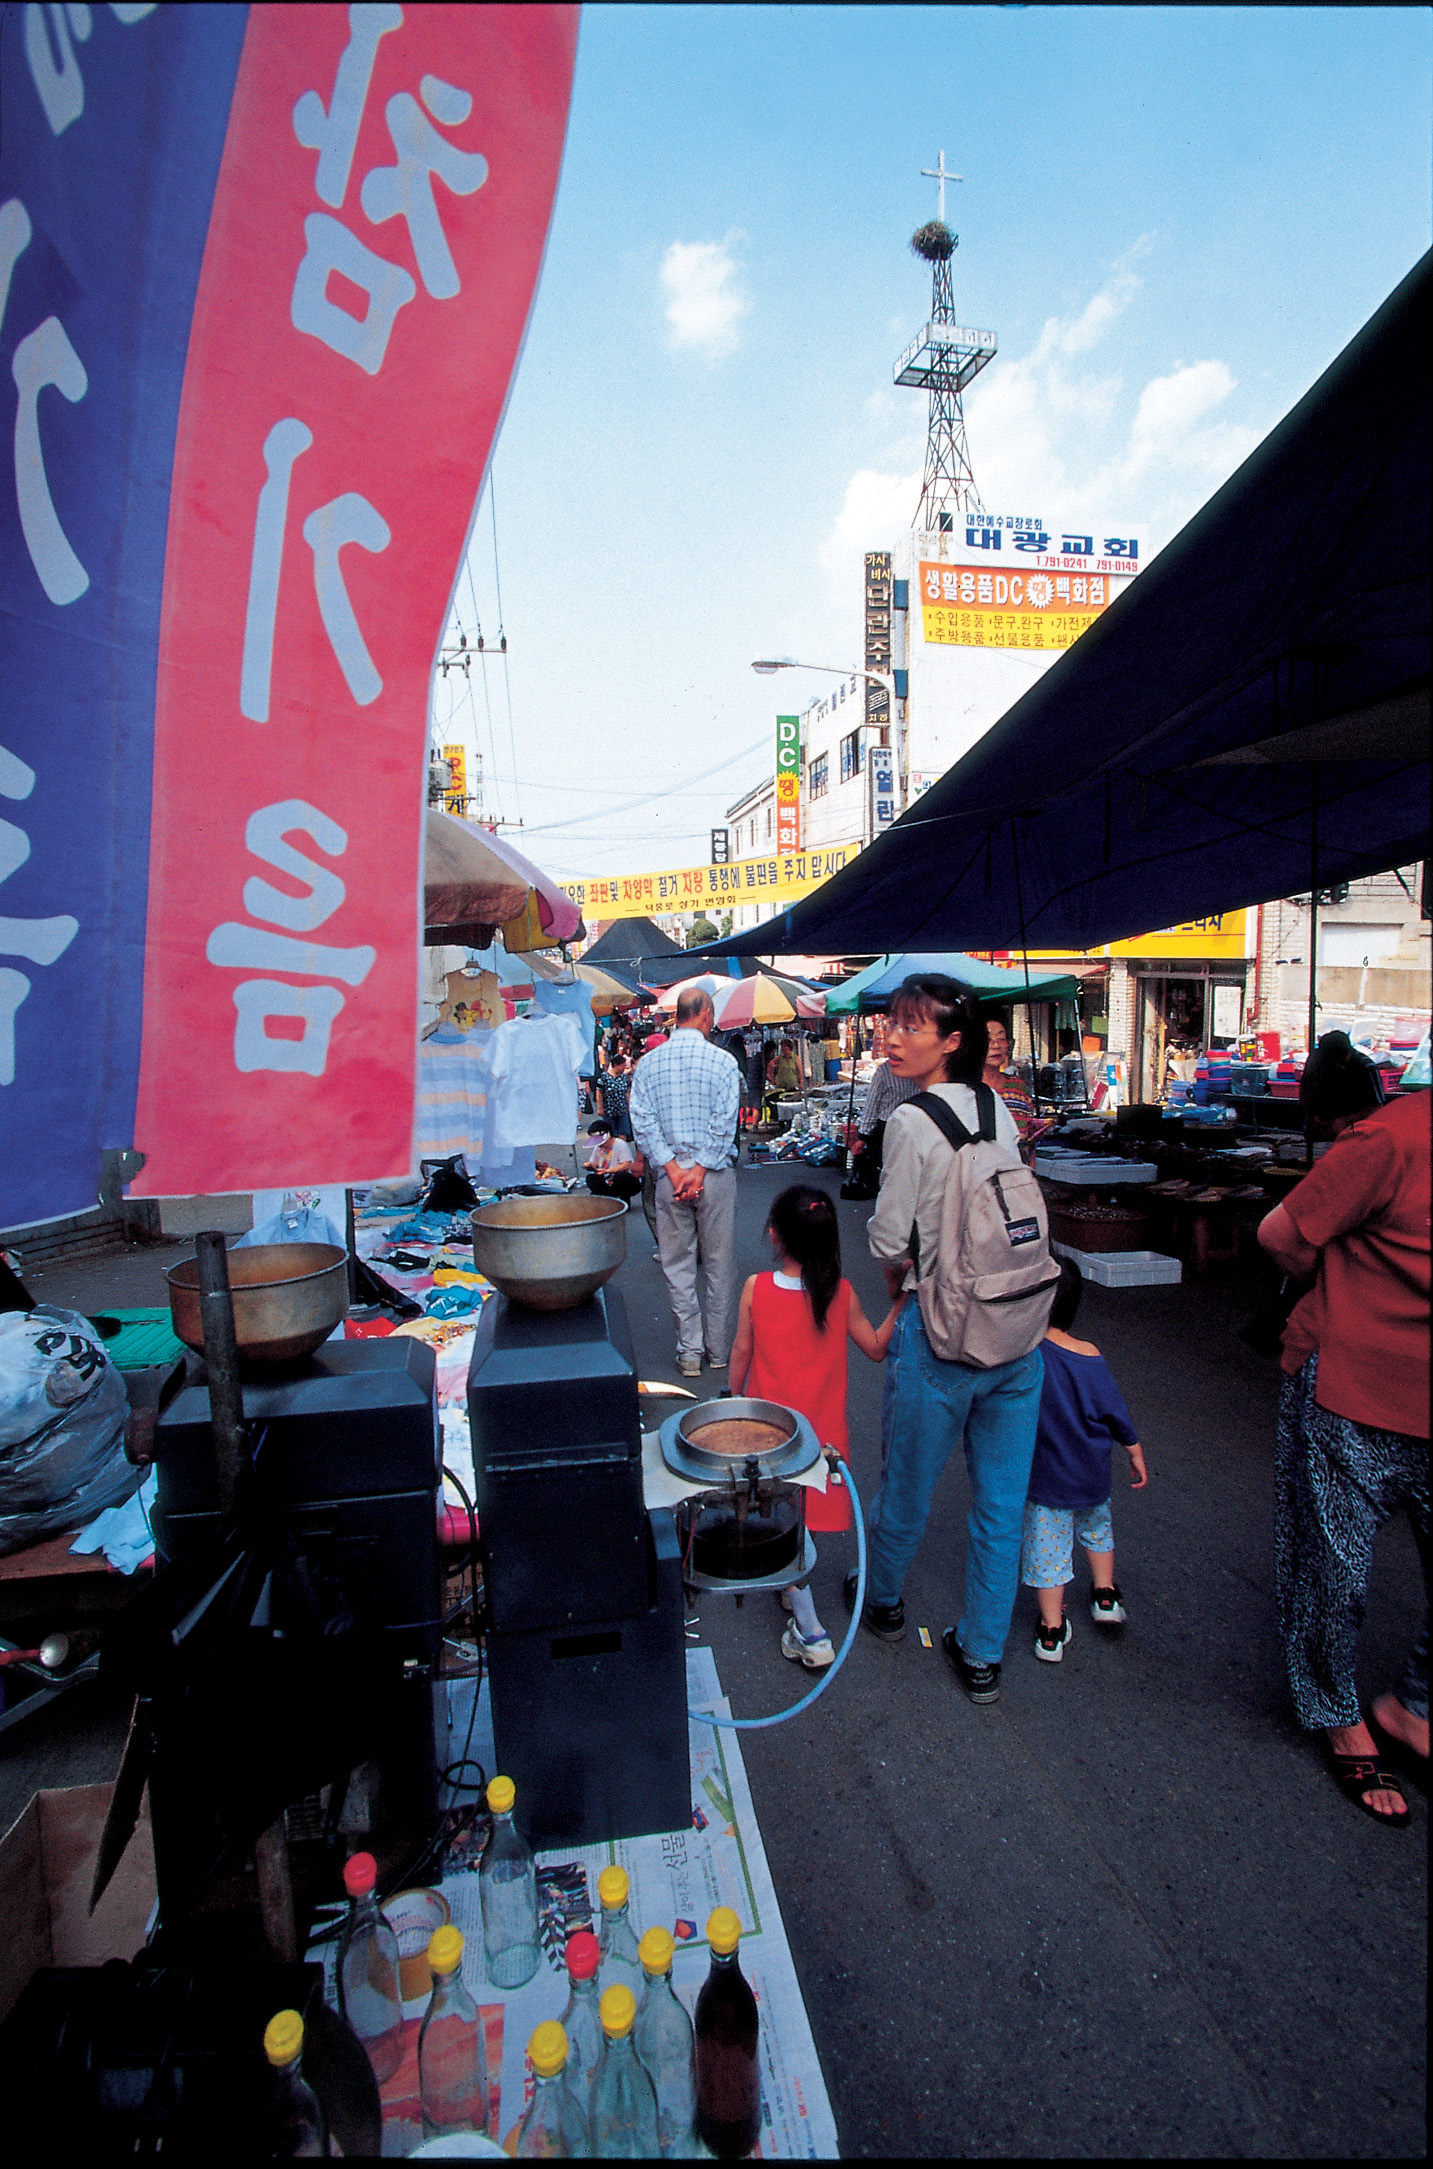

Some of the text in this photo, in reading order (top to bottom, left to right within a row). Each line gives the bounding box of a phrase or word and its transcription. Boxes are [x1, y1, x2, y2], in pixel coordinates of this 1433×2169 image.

[966, 514, 1042, 530] 대한예수교장로회
[966, 528, 1138, 559] 대광교회
[1096, 560, 1138, 572] 791-0149
[1056, 575, 1105, 605] 백화점
[935, 611, 985, 628] 수입용품
[1056, 616, 1098, 630] 가전제
[935, 627, 985, 645] 주방용품
[994, 632, 1045, 647] 선물용품
[709, 866, 740, 892] 통행에
[746, 861, 778, 887] 불편을
[661, 1834, 688, 1870] 선물
